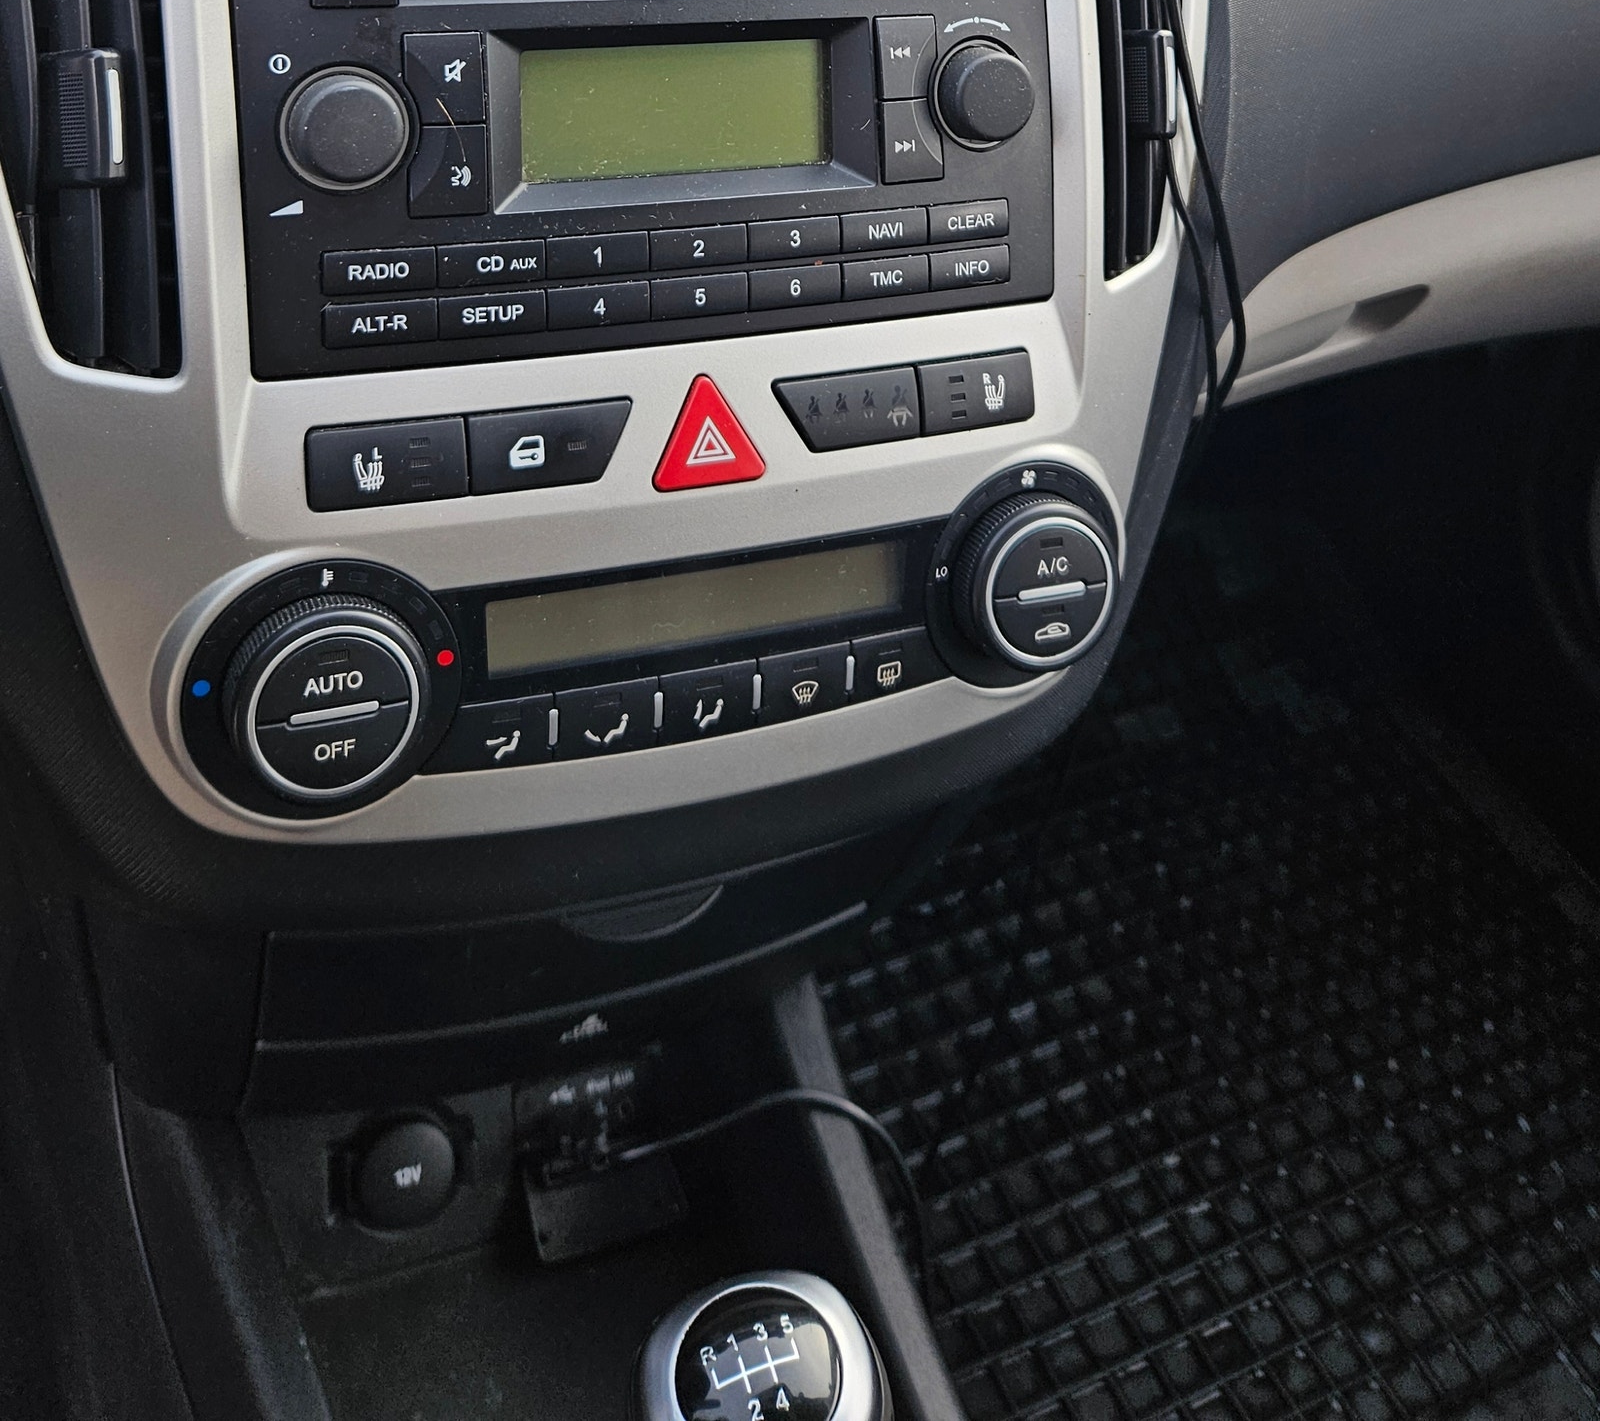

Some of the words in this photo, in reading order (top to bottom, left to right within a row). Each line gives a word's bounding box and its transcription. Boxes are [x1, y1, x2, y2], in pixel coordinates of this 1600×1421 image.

[868, 222, 904, 240] NAVI
[948, 213, 995, 231] CLEAR
[790, 230, 801, 248] 3
[593, 246, 603, 267] 1
[693, 240, 705, 257] 2
[348, 261, 410, 281] RADIO
[476, 255, 505, 273] CD
[510, 257, 538, 271] AUX
[955, 259, 990, 277] INFO
[870, 269, 904, 287] TMC
[790, 279, 801, 296] 6
[695, 288, 707, 306] 5
[461, 304, 525, 324] SETUP
[593, 298, 606, 316] 4
[351, 314, 408, 334] ALT-R
[935, 566, 949, 579] LO
[1037, 556, 1068, 576] A/C
[303, 670, 363, 697] AUTO
[314, 739, 356, 761] OFF
[700, 1345, 717, 1365] R
[727, 1333, 739, 1352] 1
[753, 1322, 768, 1341] 3
[780, 1314, 794, 1335] 5
[748, 1398, 764, 1421] 2
[776, 1387, 789, 1411] 4
